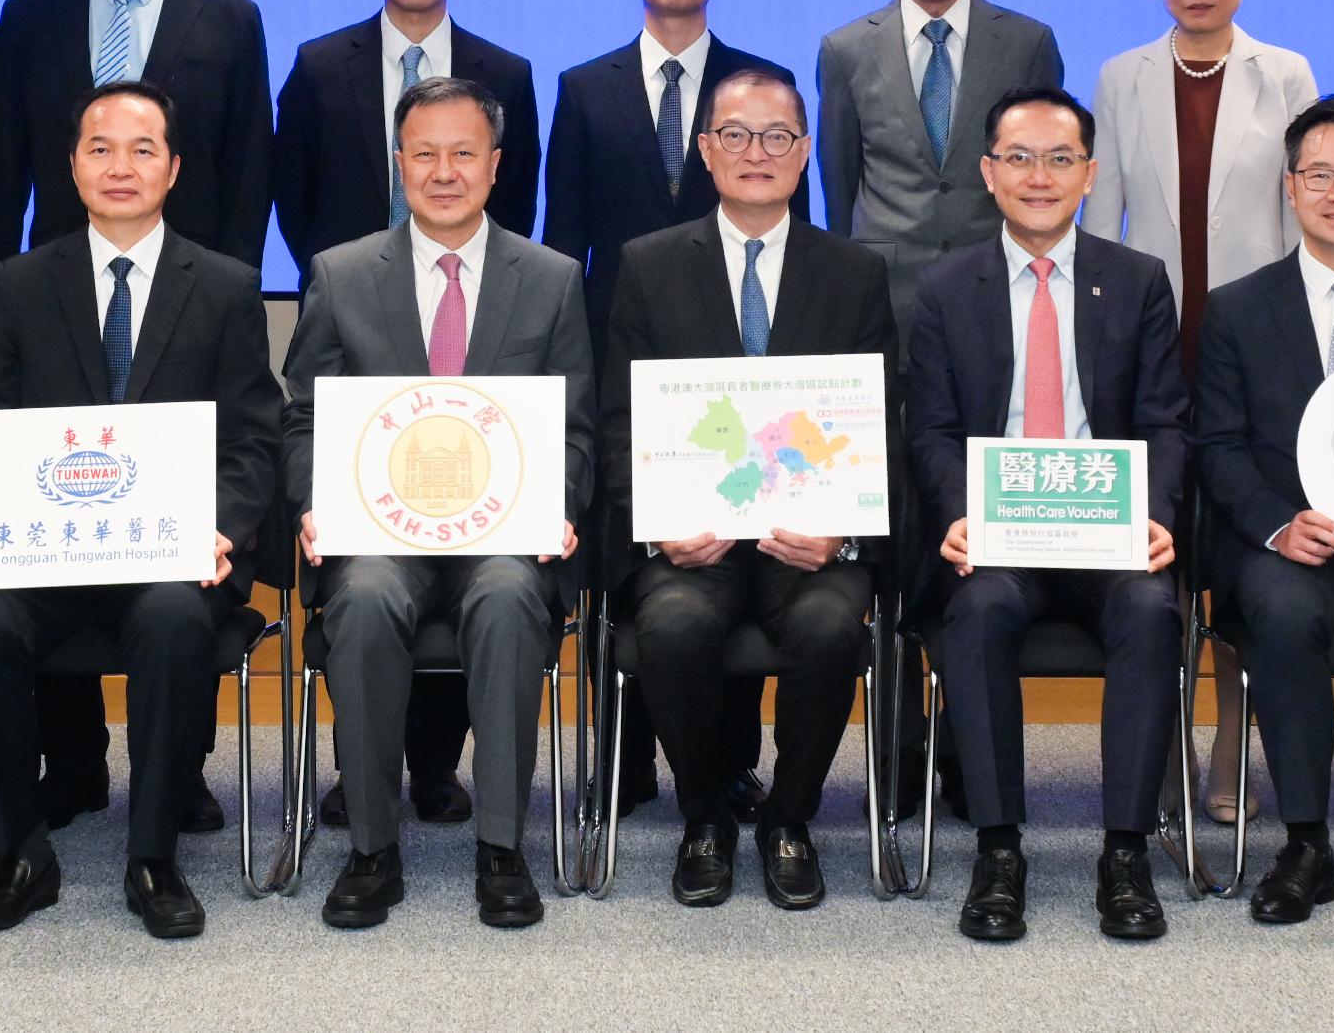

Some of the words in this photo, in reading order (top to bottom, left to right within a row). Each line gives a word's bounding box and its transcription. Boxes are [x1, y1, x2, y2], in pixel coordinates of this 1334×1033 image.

[62, 426, 117, 451] 東華
[57, 468, 118, 480] TUNGWAH
[999, 451, 1118, 494] 醫療券
[376, 493, 502, 541] FAH-SYSU
[998, 505, 1036, 517] Health
[1037, 506, 1066, 518] Care
[1067, 506, 1119, 519] Voucher
[62, 551, 121, 564] Tungwah
[125, 547, 178, 561] Hospital
